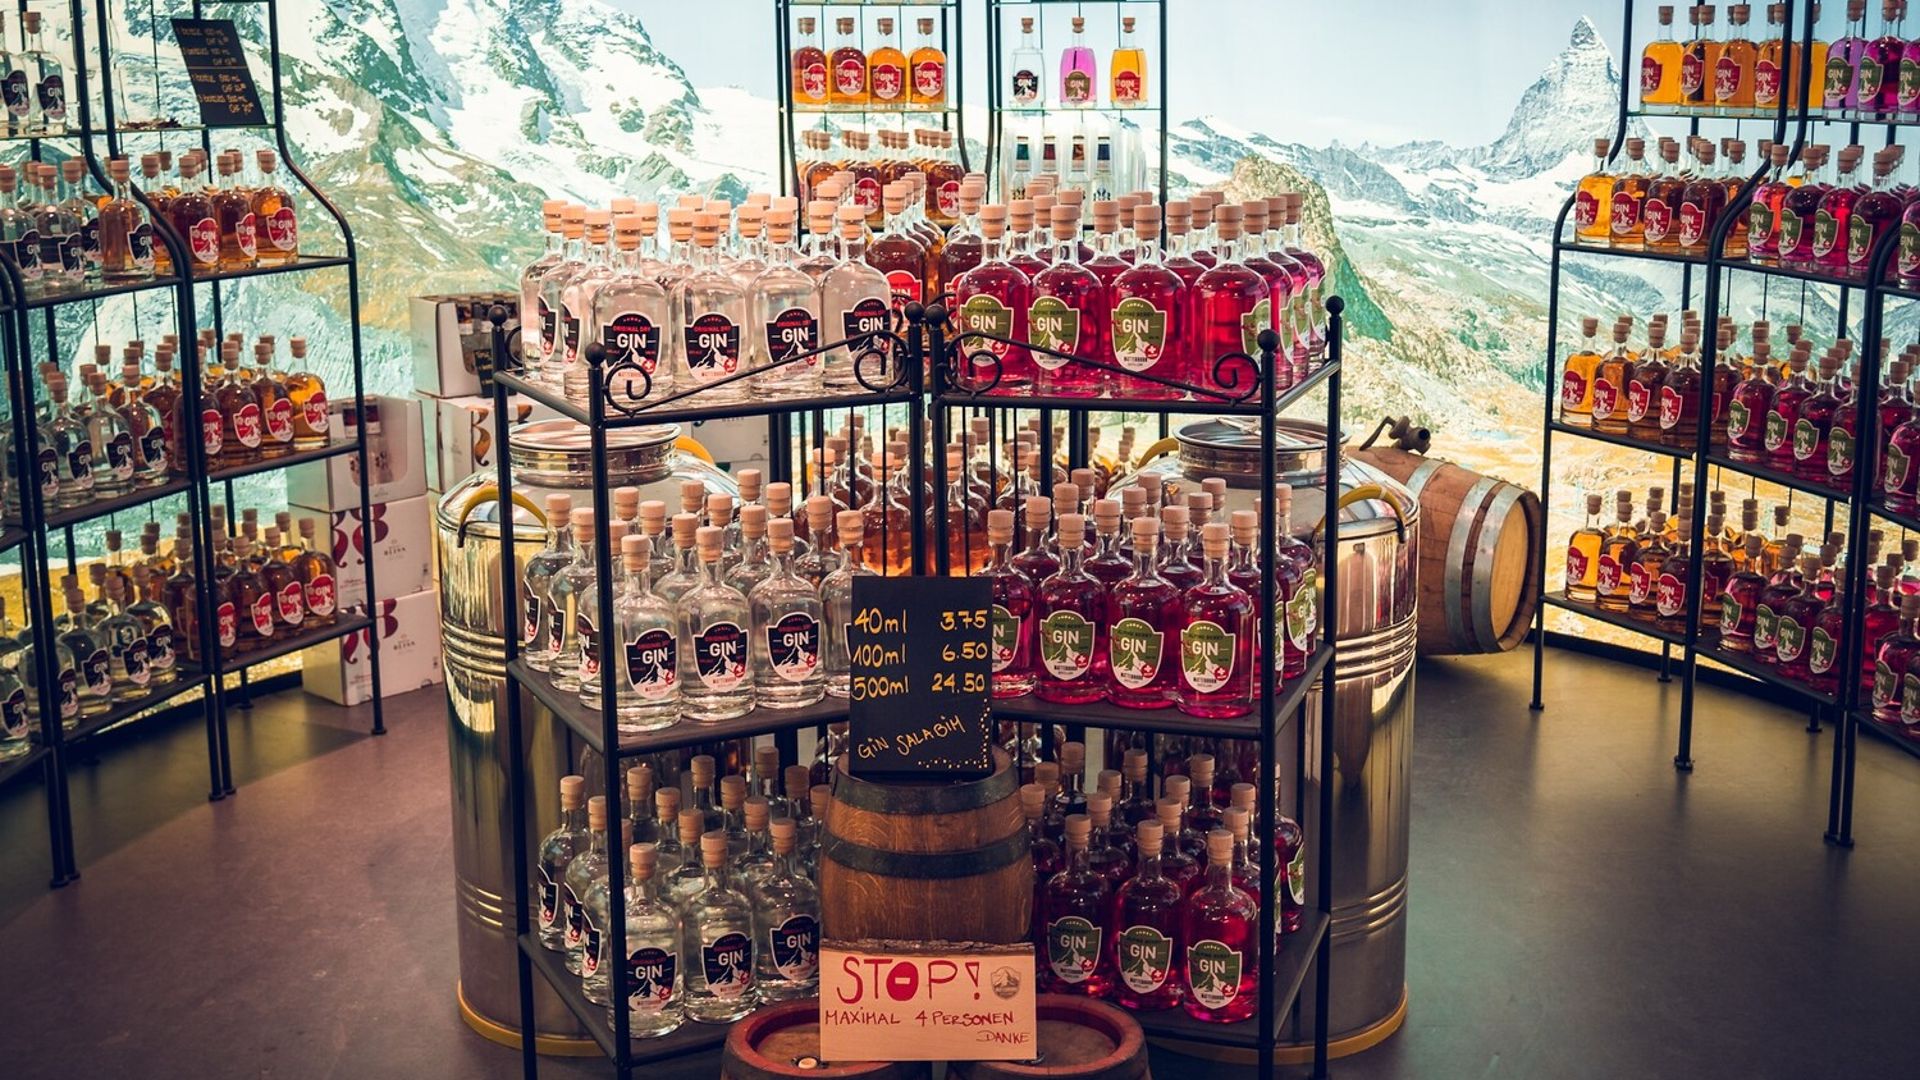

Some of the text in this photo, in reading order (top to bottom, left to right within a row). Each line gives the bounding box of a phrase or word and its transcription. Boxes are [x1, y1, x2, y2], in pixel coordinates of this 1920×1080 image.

[12, 83, 27, 93] GIN
[47, 87, 62, 97] GIN
[858, 316, 884, 332] GIN
[970, 315, 997, 330] GIN
[1037, 317, 1062, 332] GIN
[1122, 318, 1149, 334] GIN
[616, 333, 647, 349] GIN
[699, 333, 728, 349] GIN
[781, 327, 809, 343] GIN
[854, 607, 907, 634] 40ml
[940, 609, 988, 631] 3.75
[783, 631, 809, 647] GIN
[1052, 629, 1080, 644] GIN
[709, 641, 737, 657] GIN
[1120, 637, 1146, 653] GIN
[1192, 640, 1219, 656] GIN
[642, 647, 668, 664] GIN
[852, 641, 988, 668] 100ml 6.50
[851, 672, 985, 701] 500ml 24.50
[858, 714, 966, 760] GIN SALABIM
[786, 931, 811, 949] GIN
[1060, 935, 1086, 949] GIN
[718, 949, 743, 966] GIN
[1130, 943, 1157, 959] GIN
[635, 964, 663, 979] GIN
[1200, 958, 1226, 974] GIN
[825, 1006, 1014, 1027] MAXIMAL 4 PERSONEN
[976, 1029, 1030, 1045] DANKE
